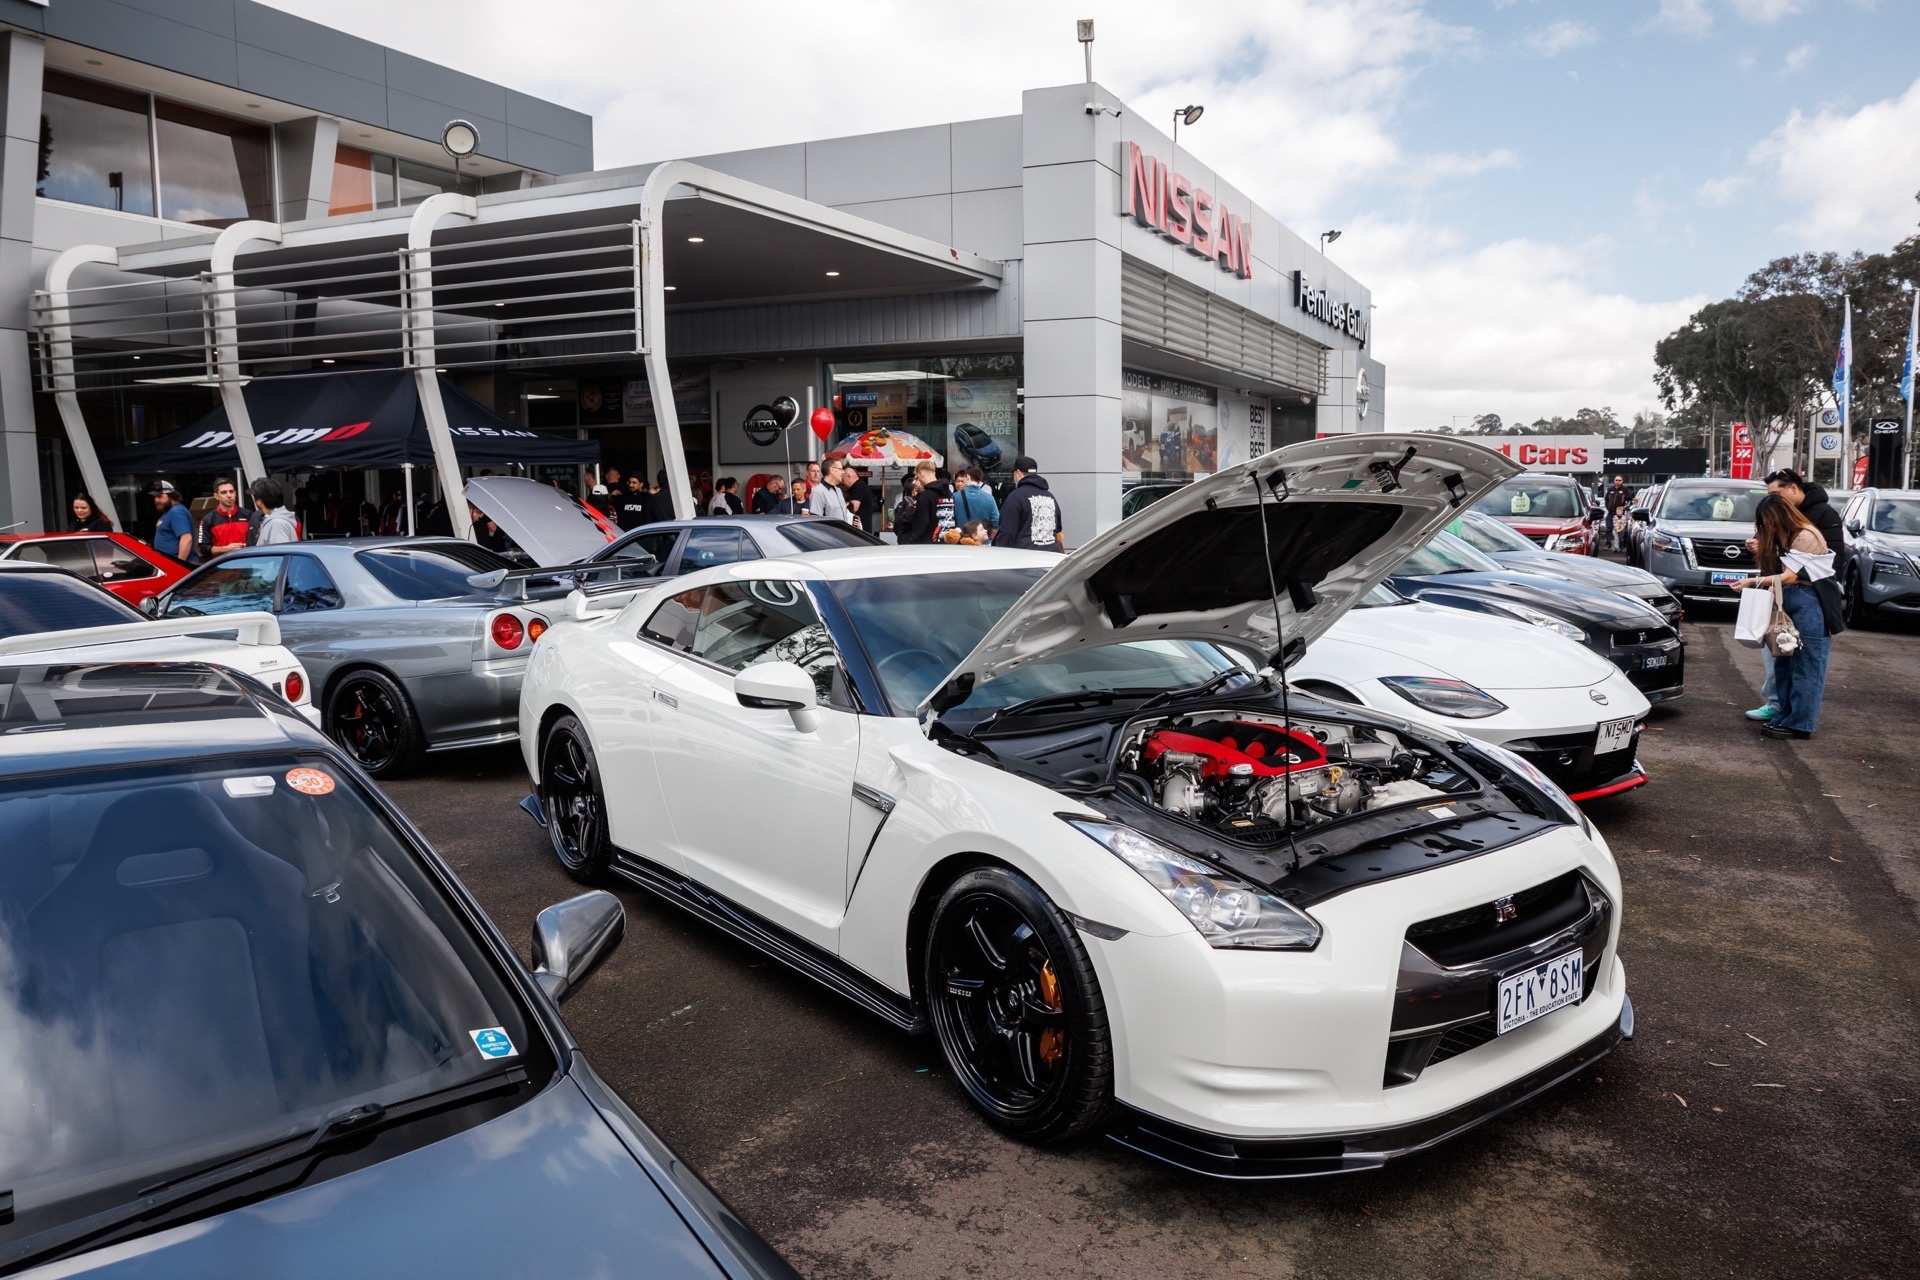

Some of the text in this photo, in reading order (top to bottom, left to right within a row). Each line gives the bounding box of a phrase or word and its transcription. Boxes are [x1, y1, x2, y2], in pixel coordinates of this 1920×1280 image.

[1127, 141, 1252, 280] NISSAN
[1297, 270, 1368, 350] Ferntree Gully
[1161, 380, 1179, 395] HAVE
[1180, 384, 1207, 400] ARRIVED!
[981, 411, 1011, 419] IT FOR
[988, 403, 1011, 412] TAKE
[1250, 404, 1265, 424] BEST
[427, 427, 539, 438] ISSAN
[984, 427, 1011, 435] GLIDE
[1250, 425, 1256, 439] OF
[1250, 441, 1265, 459] BEST
[1519, 443, 1589, 465] Cars
[1605, 720, 1632, 738] NISMO
[1613, 737, 1620, 750] Z
[302, 777, 320, 786] 30
[1503, 976, 1535, 1021] 2FK
[1550, 957, 1580, 999] 8SM
[1503, 1014, 1526, 1030] VICTORIA
[1530, 1008, 1538, 1019] THE
[1540, 997, 1564, 1014] EDUCATION
[1565, 991, 1578, 1003] STATE
